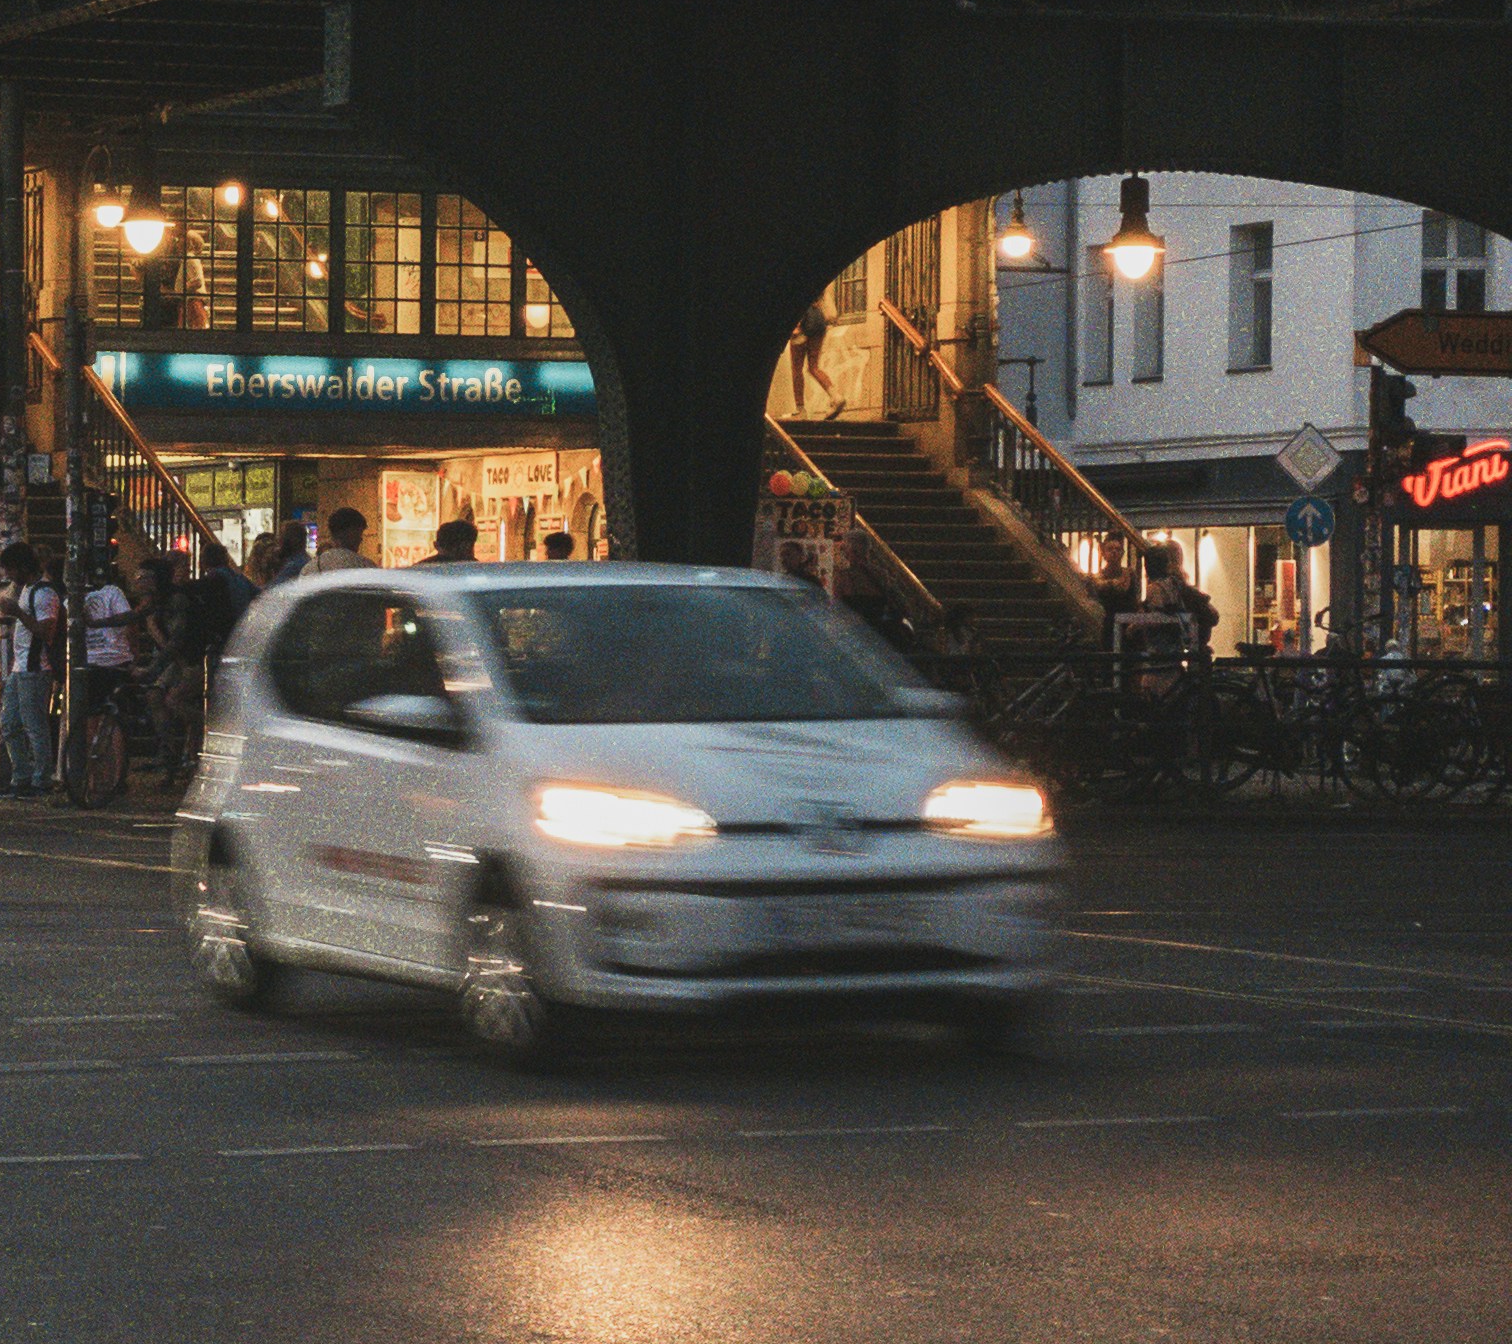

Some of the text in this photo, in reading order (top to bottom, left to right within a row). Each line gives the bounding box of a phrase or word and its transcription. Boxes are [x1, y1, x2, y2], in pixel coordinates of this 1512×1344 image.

[206, 362, 522, 403] Eberswalder Straße
[487, 463, 552, 485] TACO LOVE
[775, 501, 836, 519] TACO
